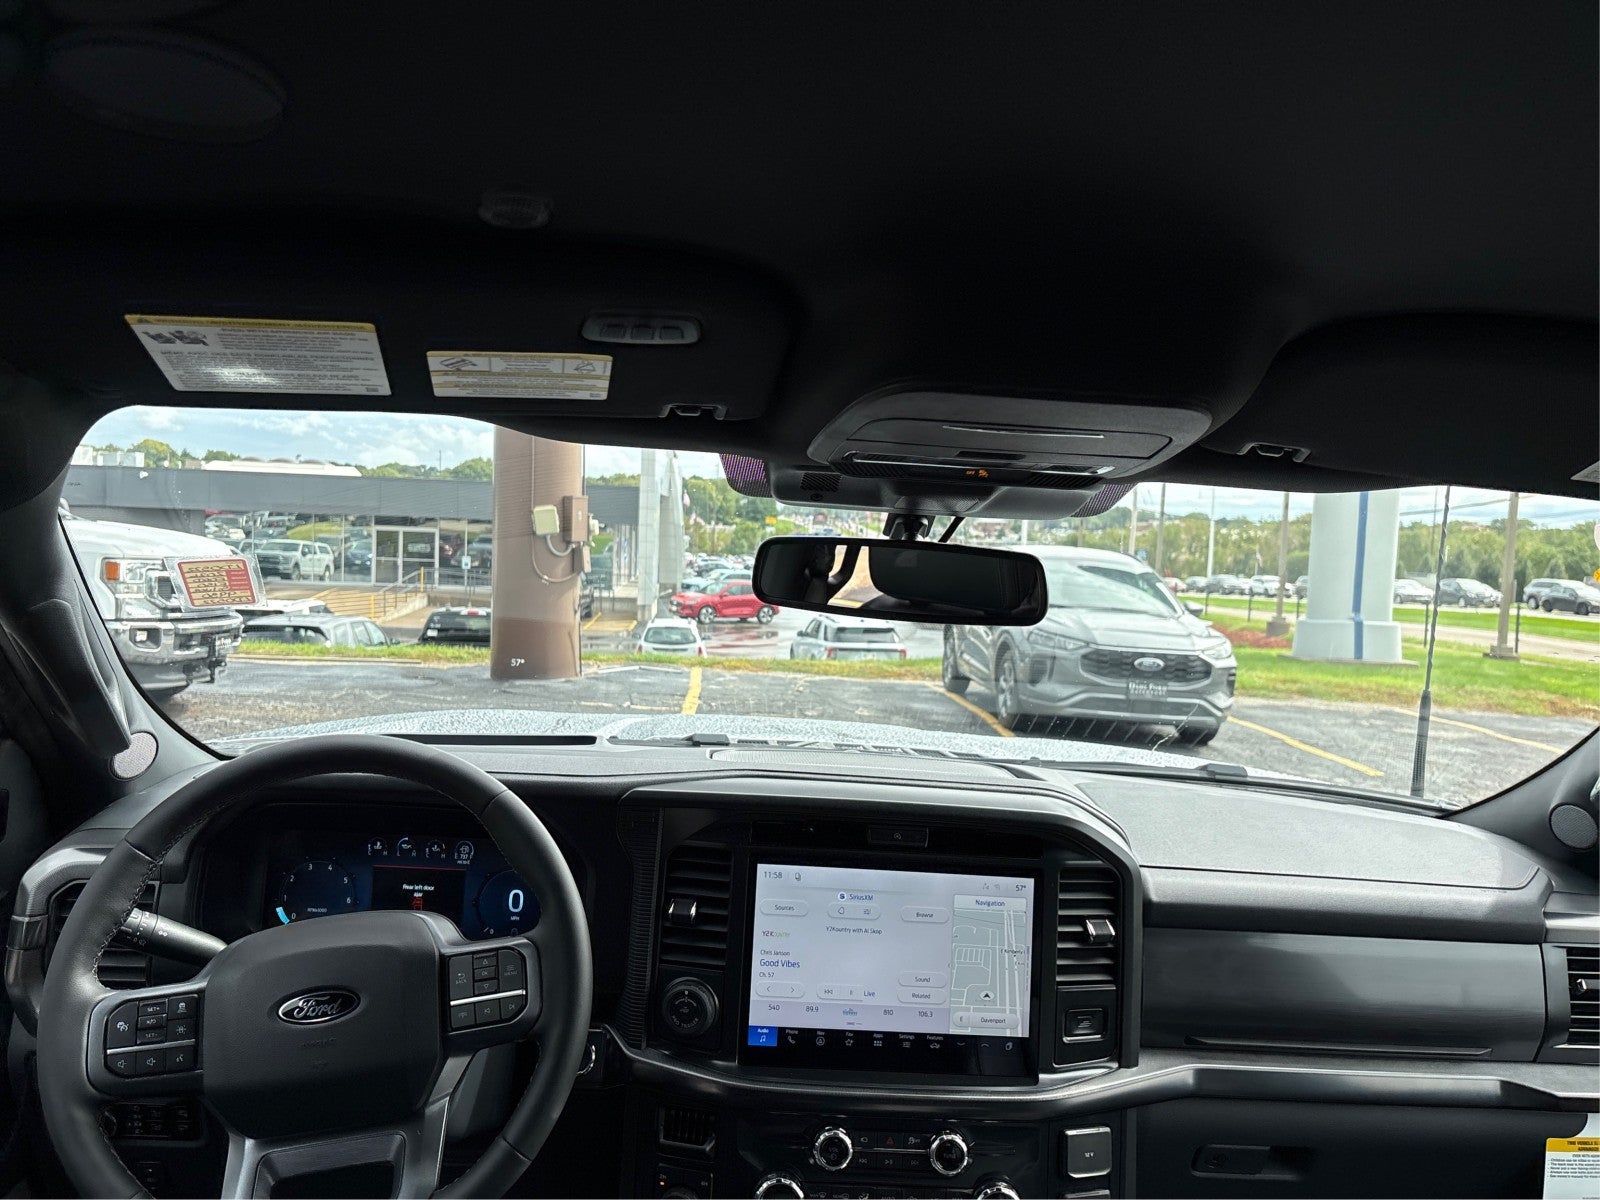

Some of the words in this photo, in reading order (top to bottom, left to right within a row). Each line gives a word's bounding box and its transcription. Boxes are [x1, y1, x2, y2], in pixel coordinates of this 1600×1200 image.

[511, 658, 525, 667] 57°
[508, 890, 524, 912] 0
[760, 959, 779, 967] Good
[781, 960, 800, 968] Vibes
[293, 995, 342, 1018] Ford
